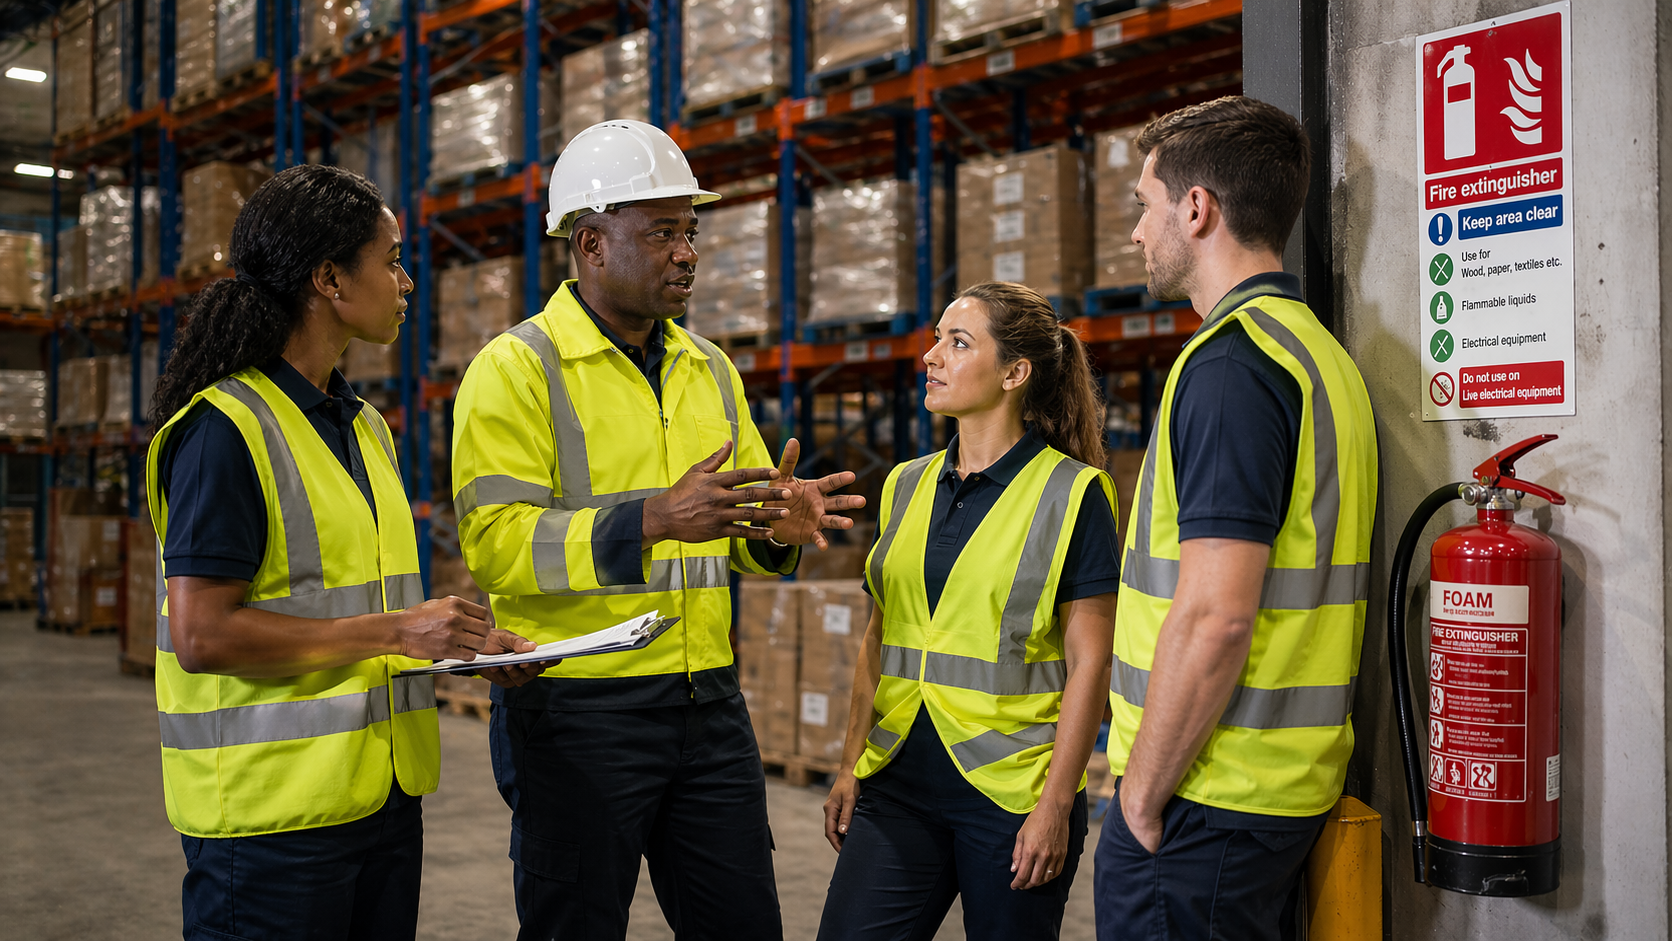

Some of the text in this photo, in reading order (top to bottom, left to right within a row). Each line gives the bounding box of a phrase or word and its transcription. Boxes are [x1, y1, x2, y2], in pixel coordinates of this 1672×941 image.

[1430, 168, 1557, 202] Fire extinguisher
[1463, 206, 1558, 231] Keep area clear
[1462, 249, 1490, 262] Use for
[1462, 257, 1562, 278] Wood, paper, textiles etc.
[1462, 293, 1536, 310] Flammable liquids
[1462, 332, 1546, 348] Electrical equipment
[1463, 372, 1519, 383] Do not use on
[1463, 386, 1561, 401] Live electrical equipment
[1443, 590, 1492, 608] FOAM
[1446, 629, 1518, 642] EXTINGUISHER
